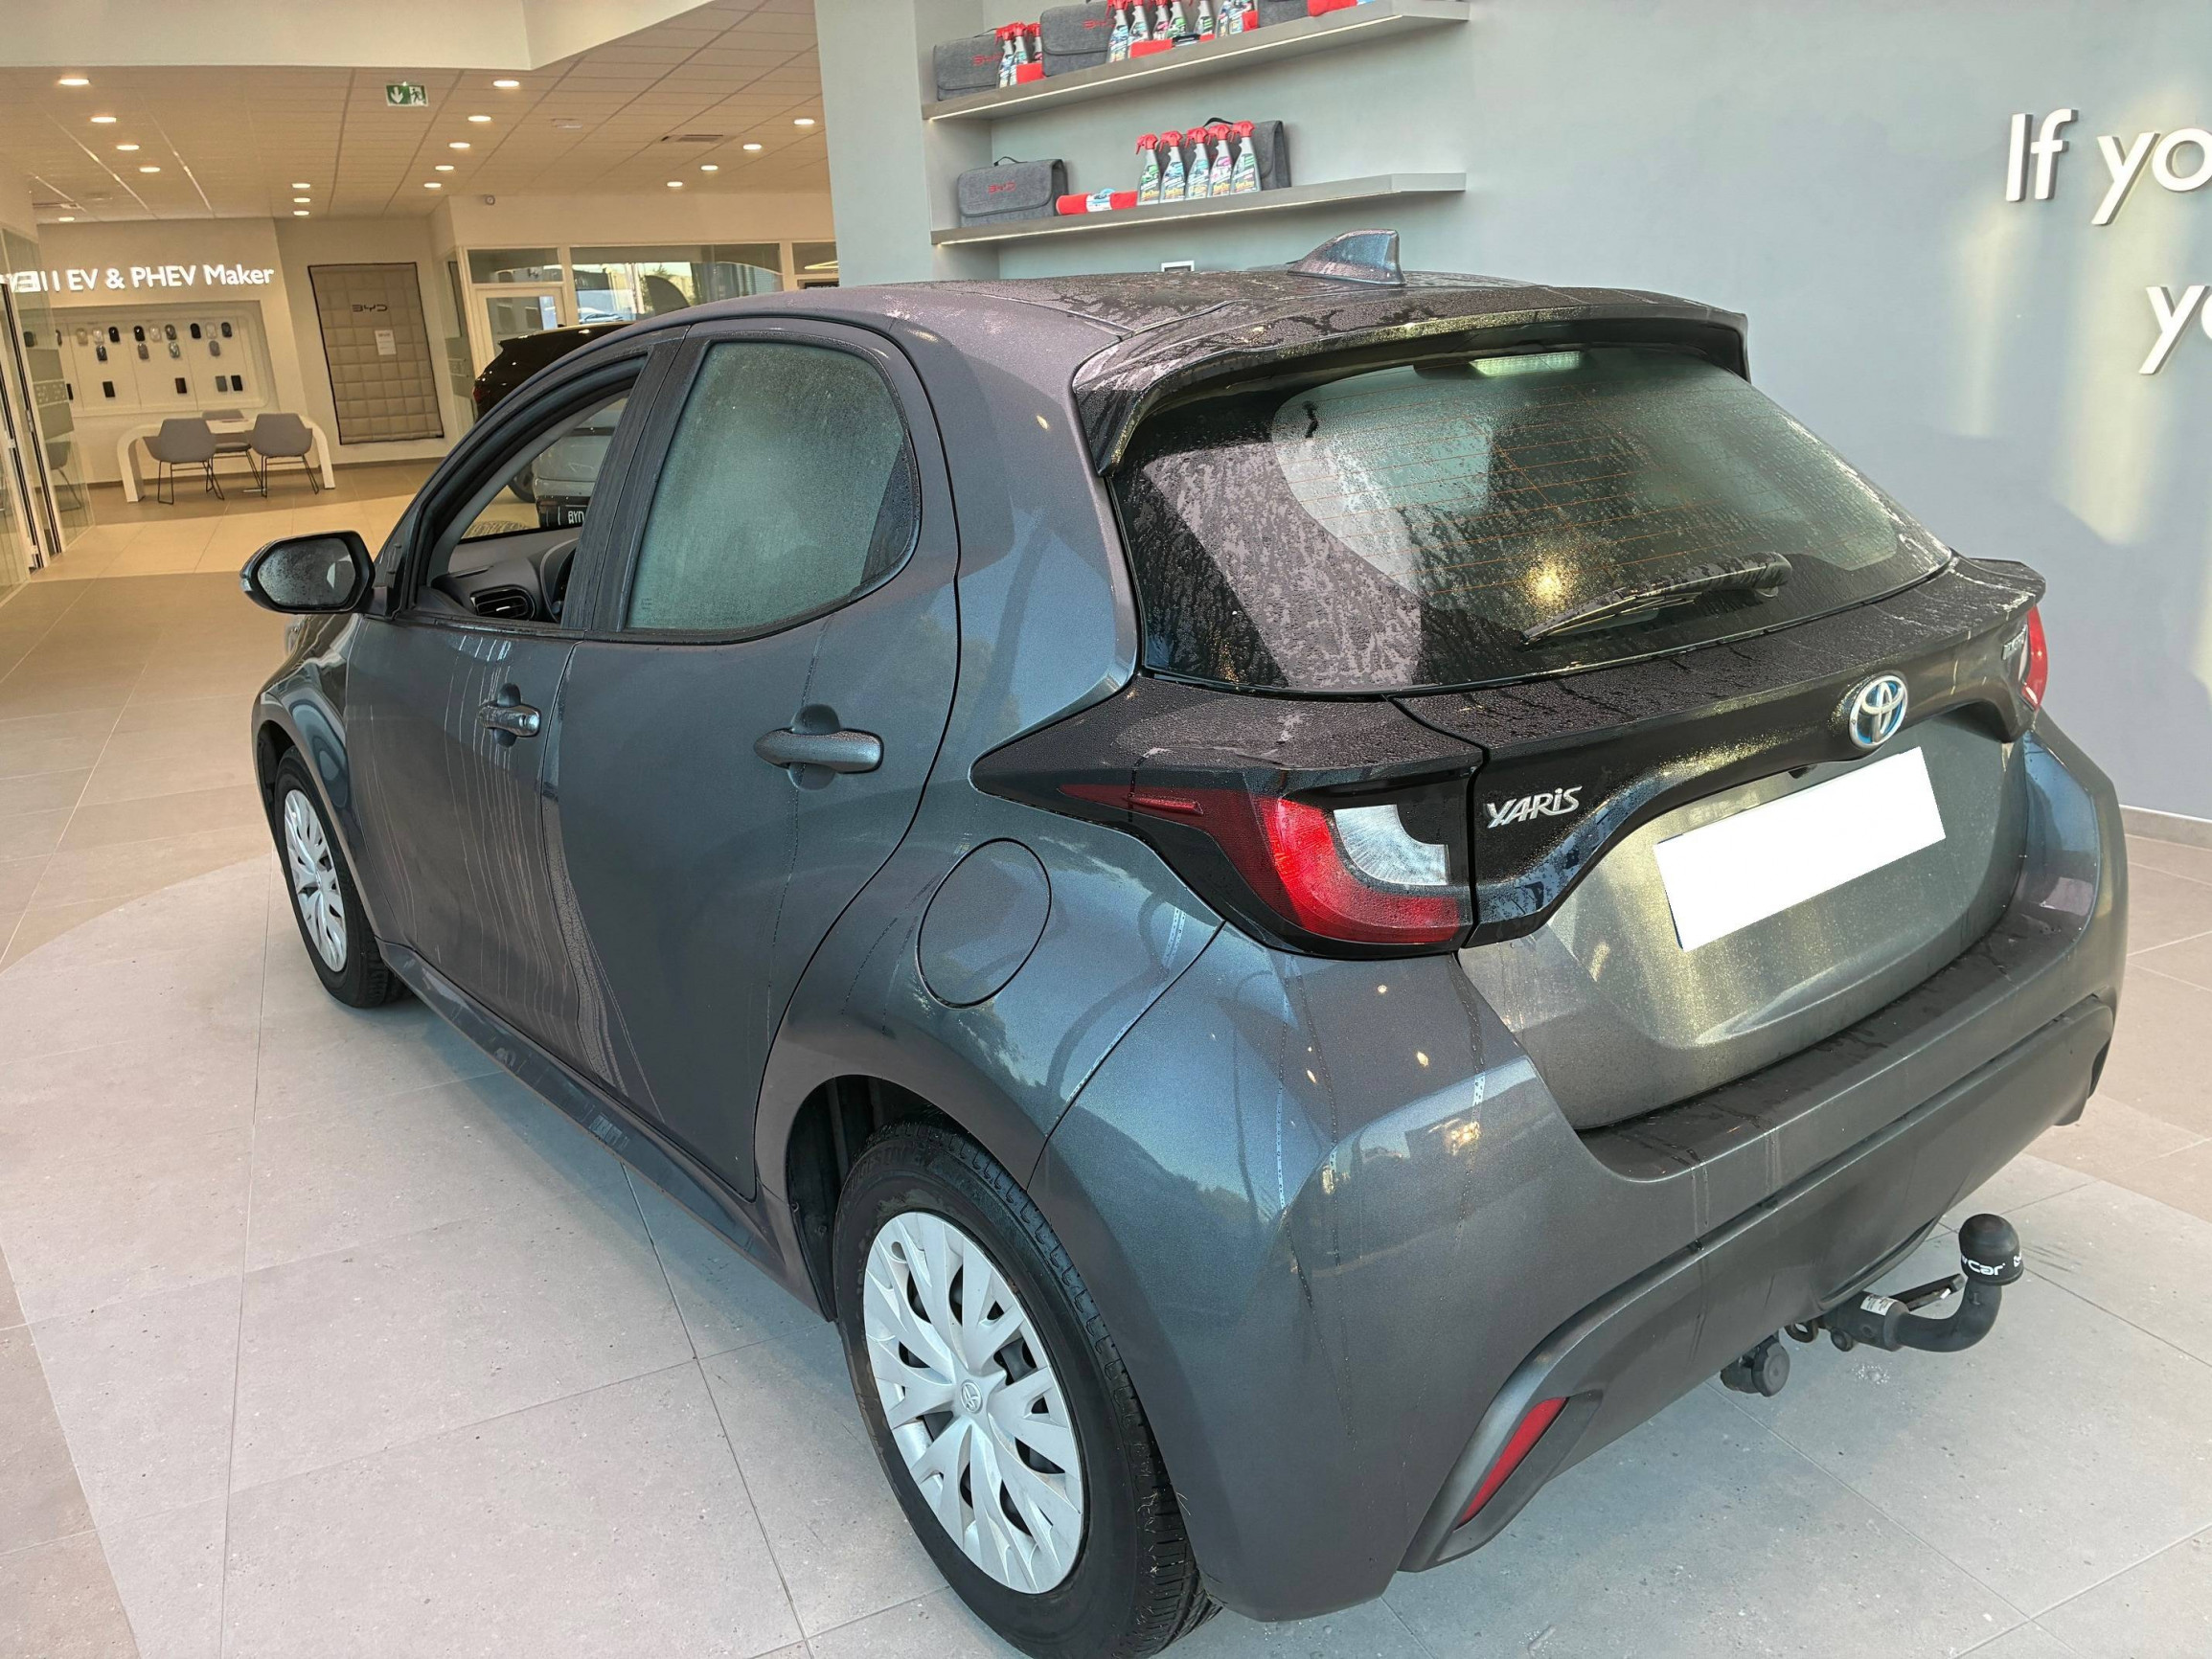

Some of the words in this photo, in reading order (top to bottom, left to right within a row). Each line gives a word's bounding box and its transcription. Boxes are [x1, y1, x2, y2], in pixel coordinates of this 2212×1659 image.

[2006, 108, 2079, 202] If
[66, 268, 99, 291] EV
[104, 267, 125, 289] &
[130, 264, 196, 288] PHEV
[202, 263, 275, 286] Maker
[352, 304, 388, 313] BYD
[2139, 284, 2212, 375] y
